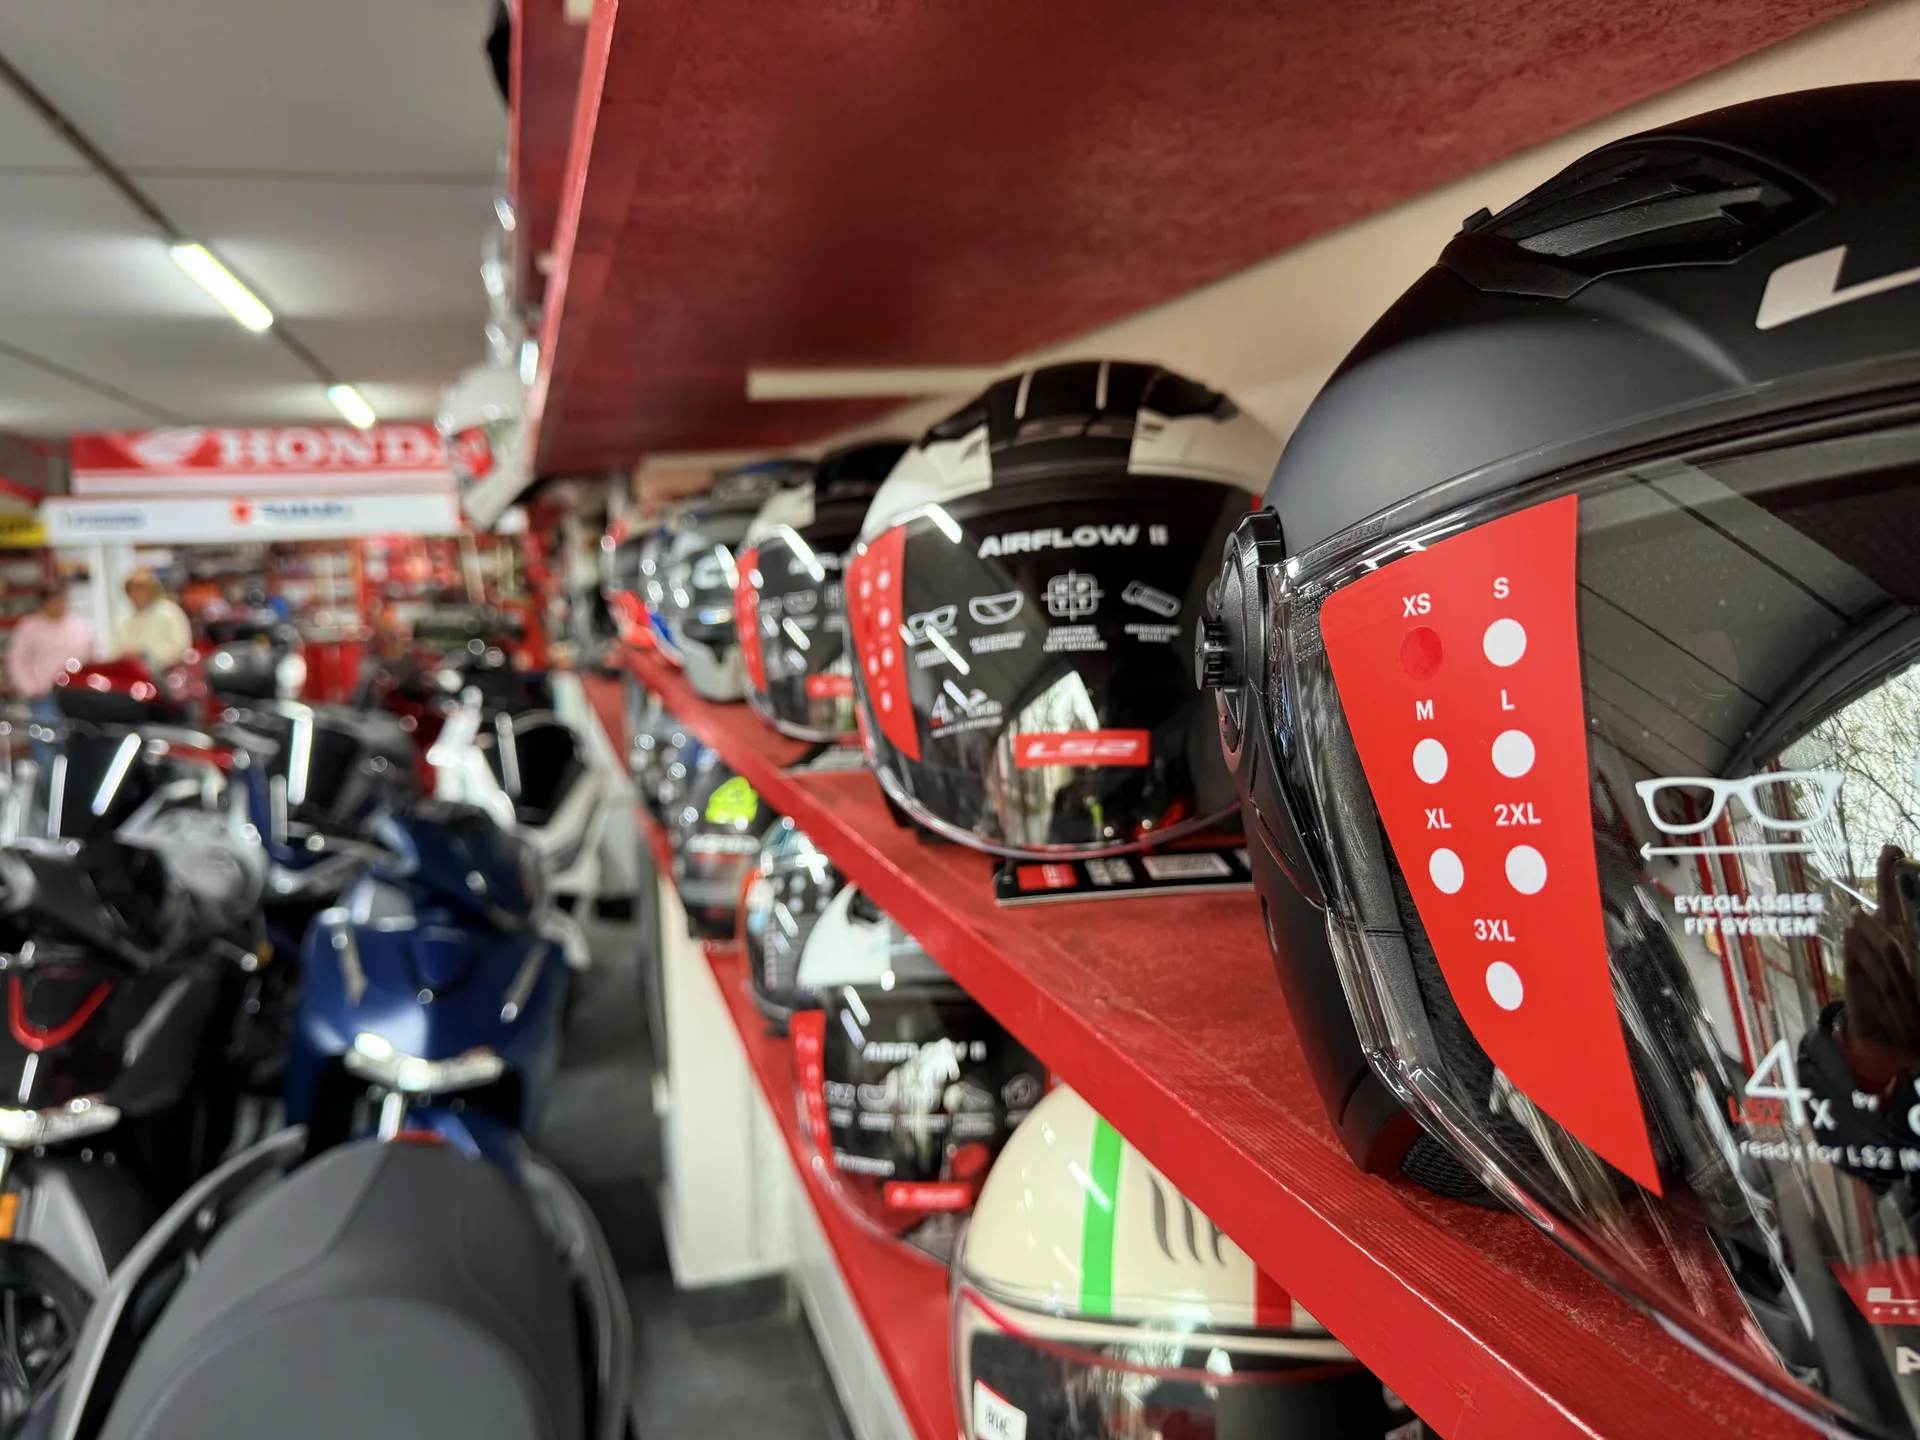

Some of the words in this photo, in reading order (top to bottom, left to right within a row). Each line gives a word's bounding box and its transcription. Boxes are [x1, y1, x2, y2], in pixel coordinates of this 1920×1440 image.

[977, 523, 1140, 559] AIRFLOW
[1402, 592, 1432, 618] XS
[1493, 576, 1510, 599] S
[1415, 699, 1434, 721] M
[1501, 689, 1515, 711] L
[1424, 808, 1452, 829] XL
[1494, 802, 1541, 826] 2XL
[1674, 892, 1825, 914] EYEGLASSES
[1473, 918, 1516, 942] 3XL
[1684, 916, 1717, 935] FIT
[1720, 915, 1818, 937] SYSTEM
[1727, 1096, 1782, 1126] LS2
[1846, 1144, 1894, 1171] LS2
